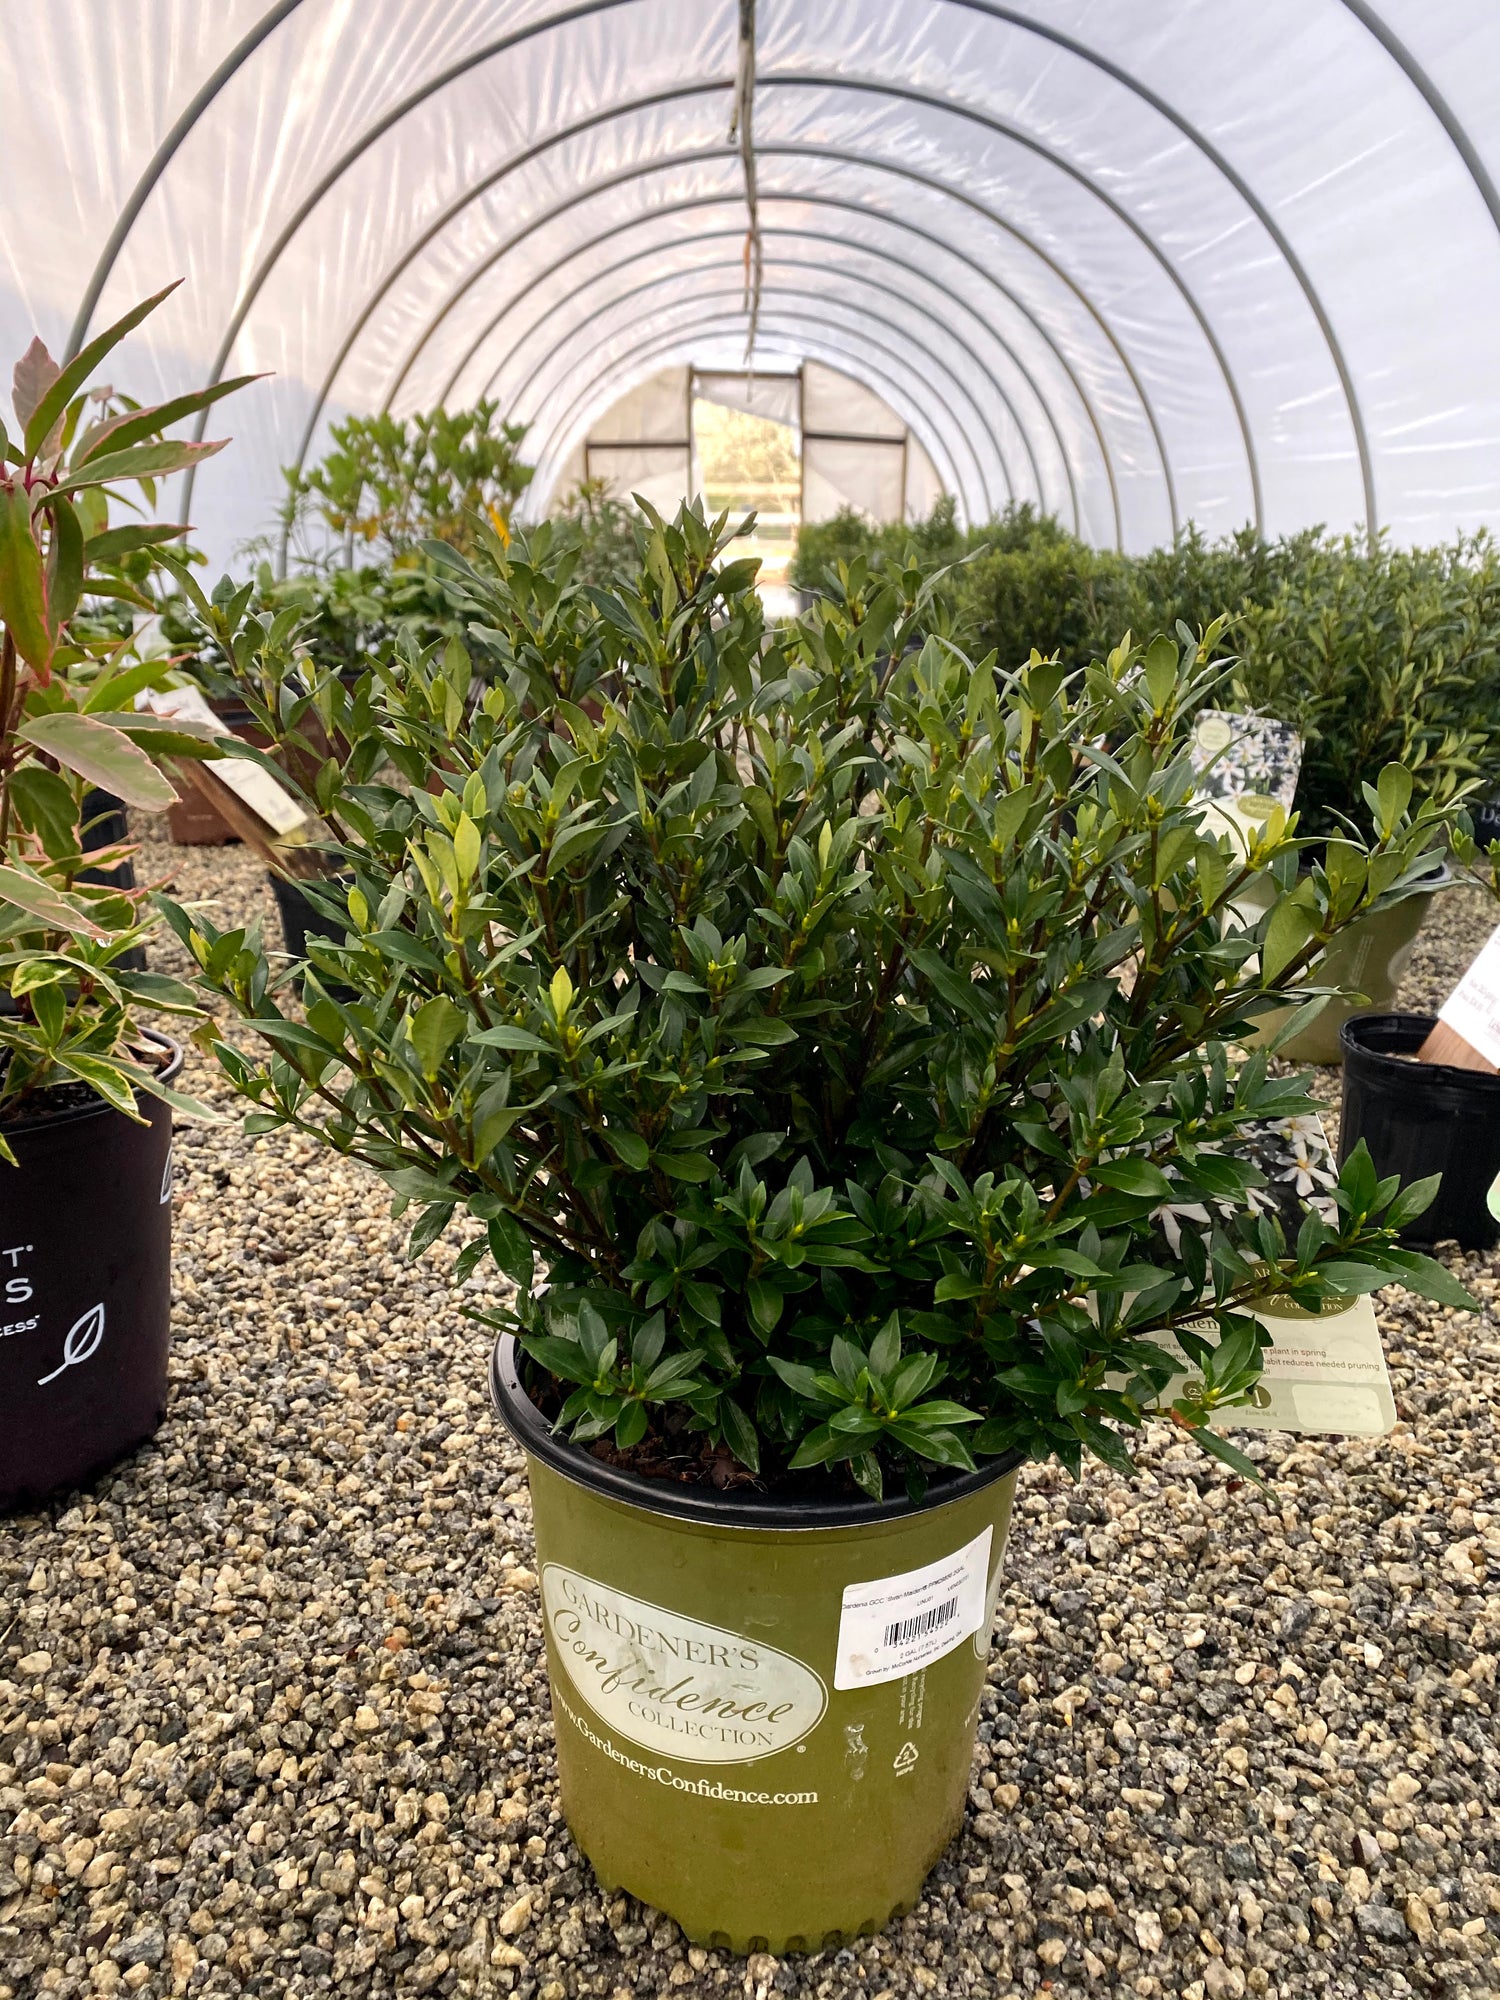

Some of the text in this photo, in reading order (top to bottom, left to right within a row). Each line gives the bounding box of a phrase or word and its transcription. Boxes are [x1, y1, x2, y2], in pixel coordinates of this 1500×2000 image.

[1269, 1347, 1290, 1356] plant
[1300, 1349, 1327, 1358] spring
[1282, 1359, 1315, 1367] reduces
[1315, 1361, 1347, 1369] needed
[1347, 1363, 1380, 1372] pruning
[562, 1578, 760, 1672] GARDENER'S
[553, 1608, 795, 1724] Confidence
[553, 1682, 819, 1805] www.GardenersConfidence.com
[628, 1700, 774, 1746] COLLECTION
